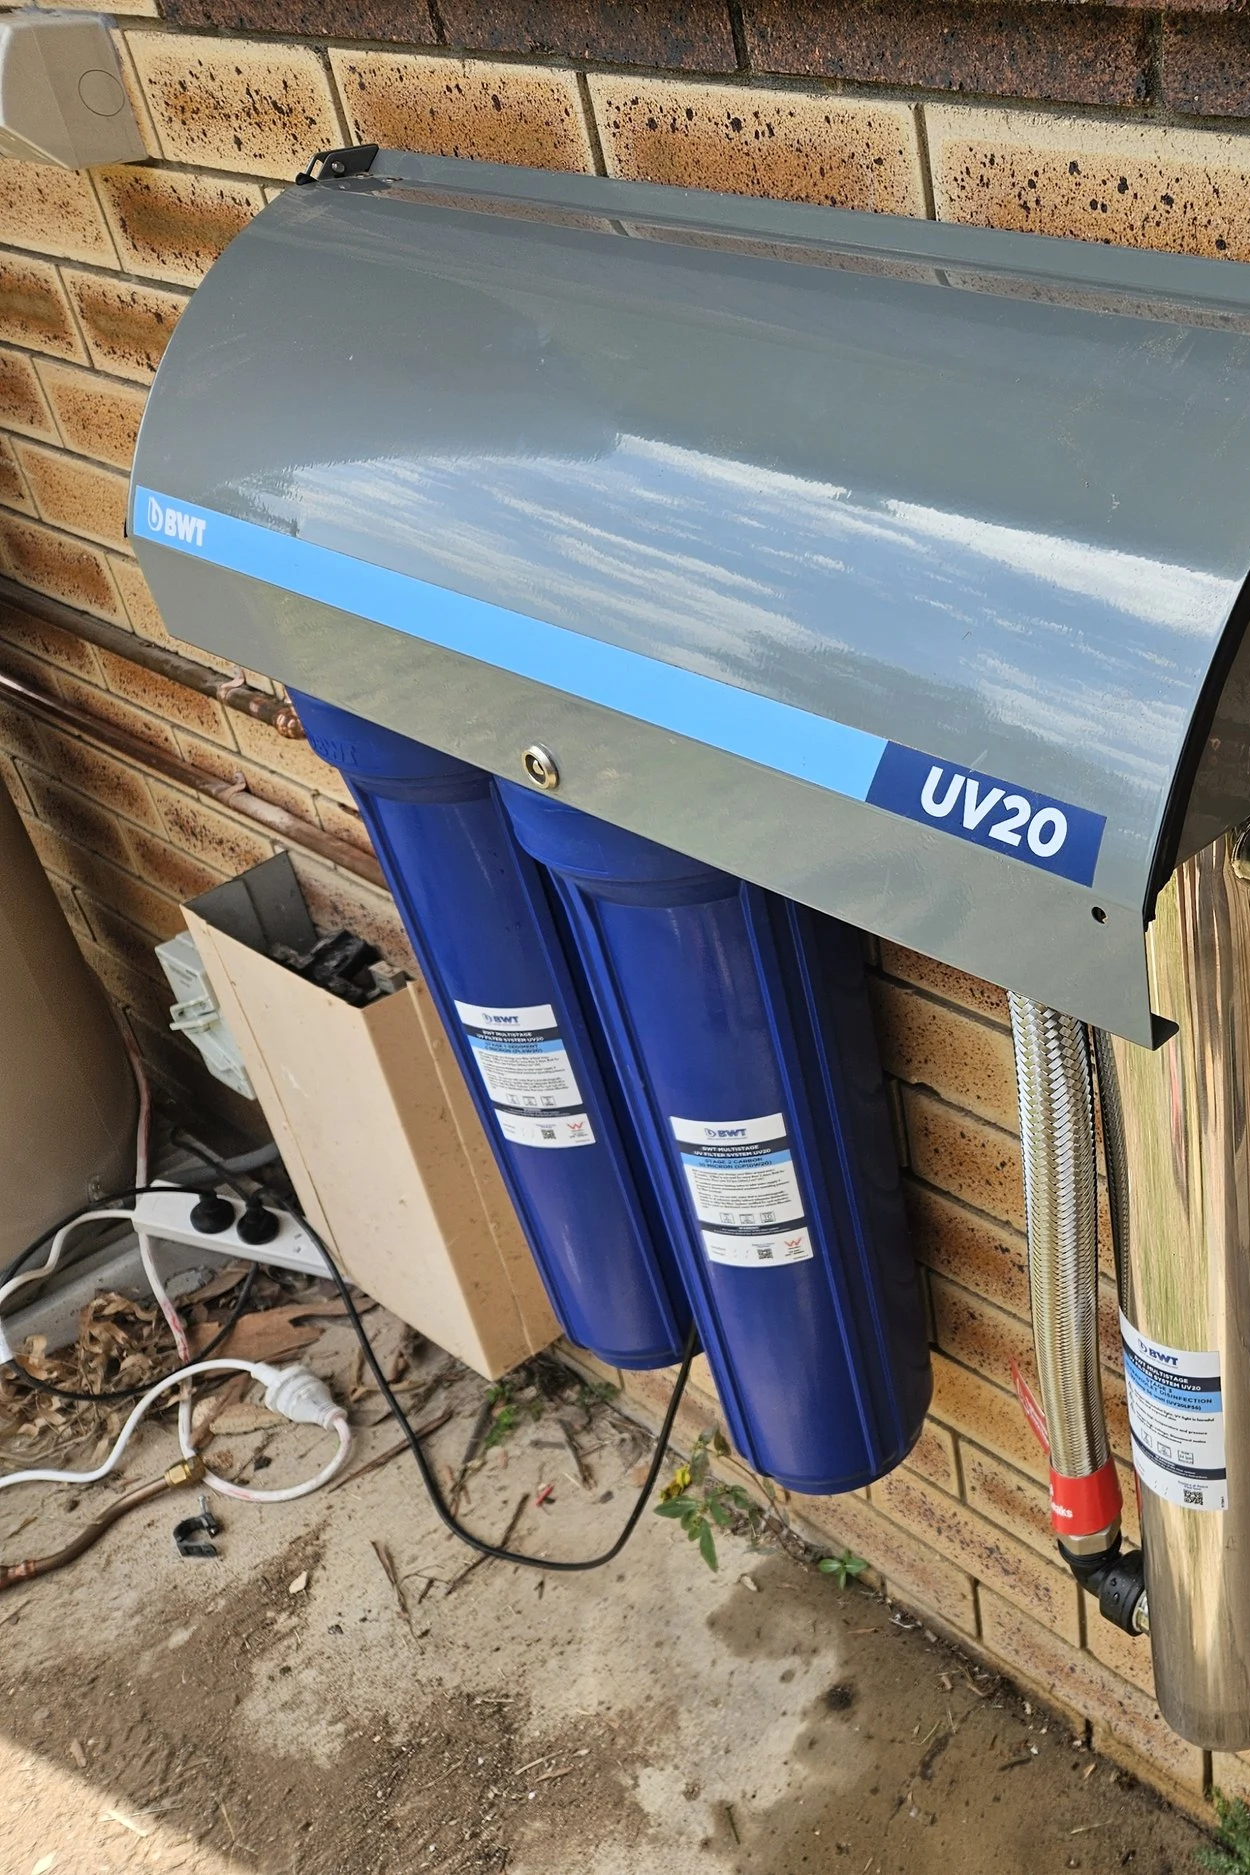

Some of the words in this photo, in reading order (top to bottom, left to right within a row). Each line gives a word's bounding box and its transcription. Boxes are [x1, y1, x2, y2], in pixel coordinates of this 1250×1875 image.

[164, 507, 207, 548] BWT
[920, 765, 1068, 858] UV20
[493, 1015, 519, 1024] BWT
[717, 1128, 747, 1138] BWT
[717, 1144, 760, 1153] MULTISTAGE
[753, 1148, 772, 1156] UV20
[734, 1157, 763, 1165] CARBON
[1148, 1347, 1179, 1366] BWT
[1146, 1364, 1189, 1384] MULTISTAGE
[1146, 1377, 1168, 1391] STAGE
[1153, 1373, 1180, 1388] SYSTEM
[1181, 1383, 1202, 1392] UV20
[1159, 1387, 1213, 1405] DISINFECTION
